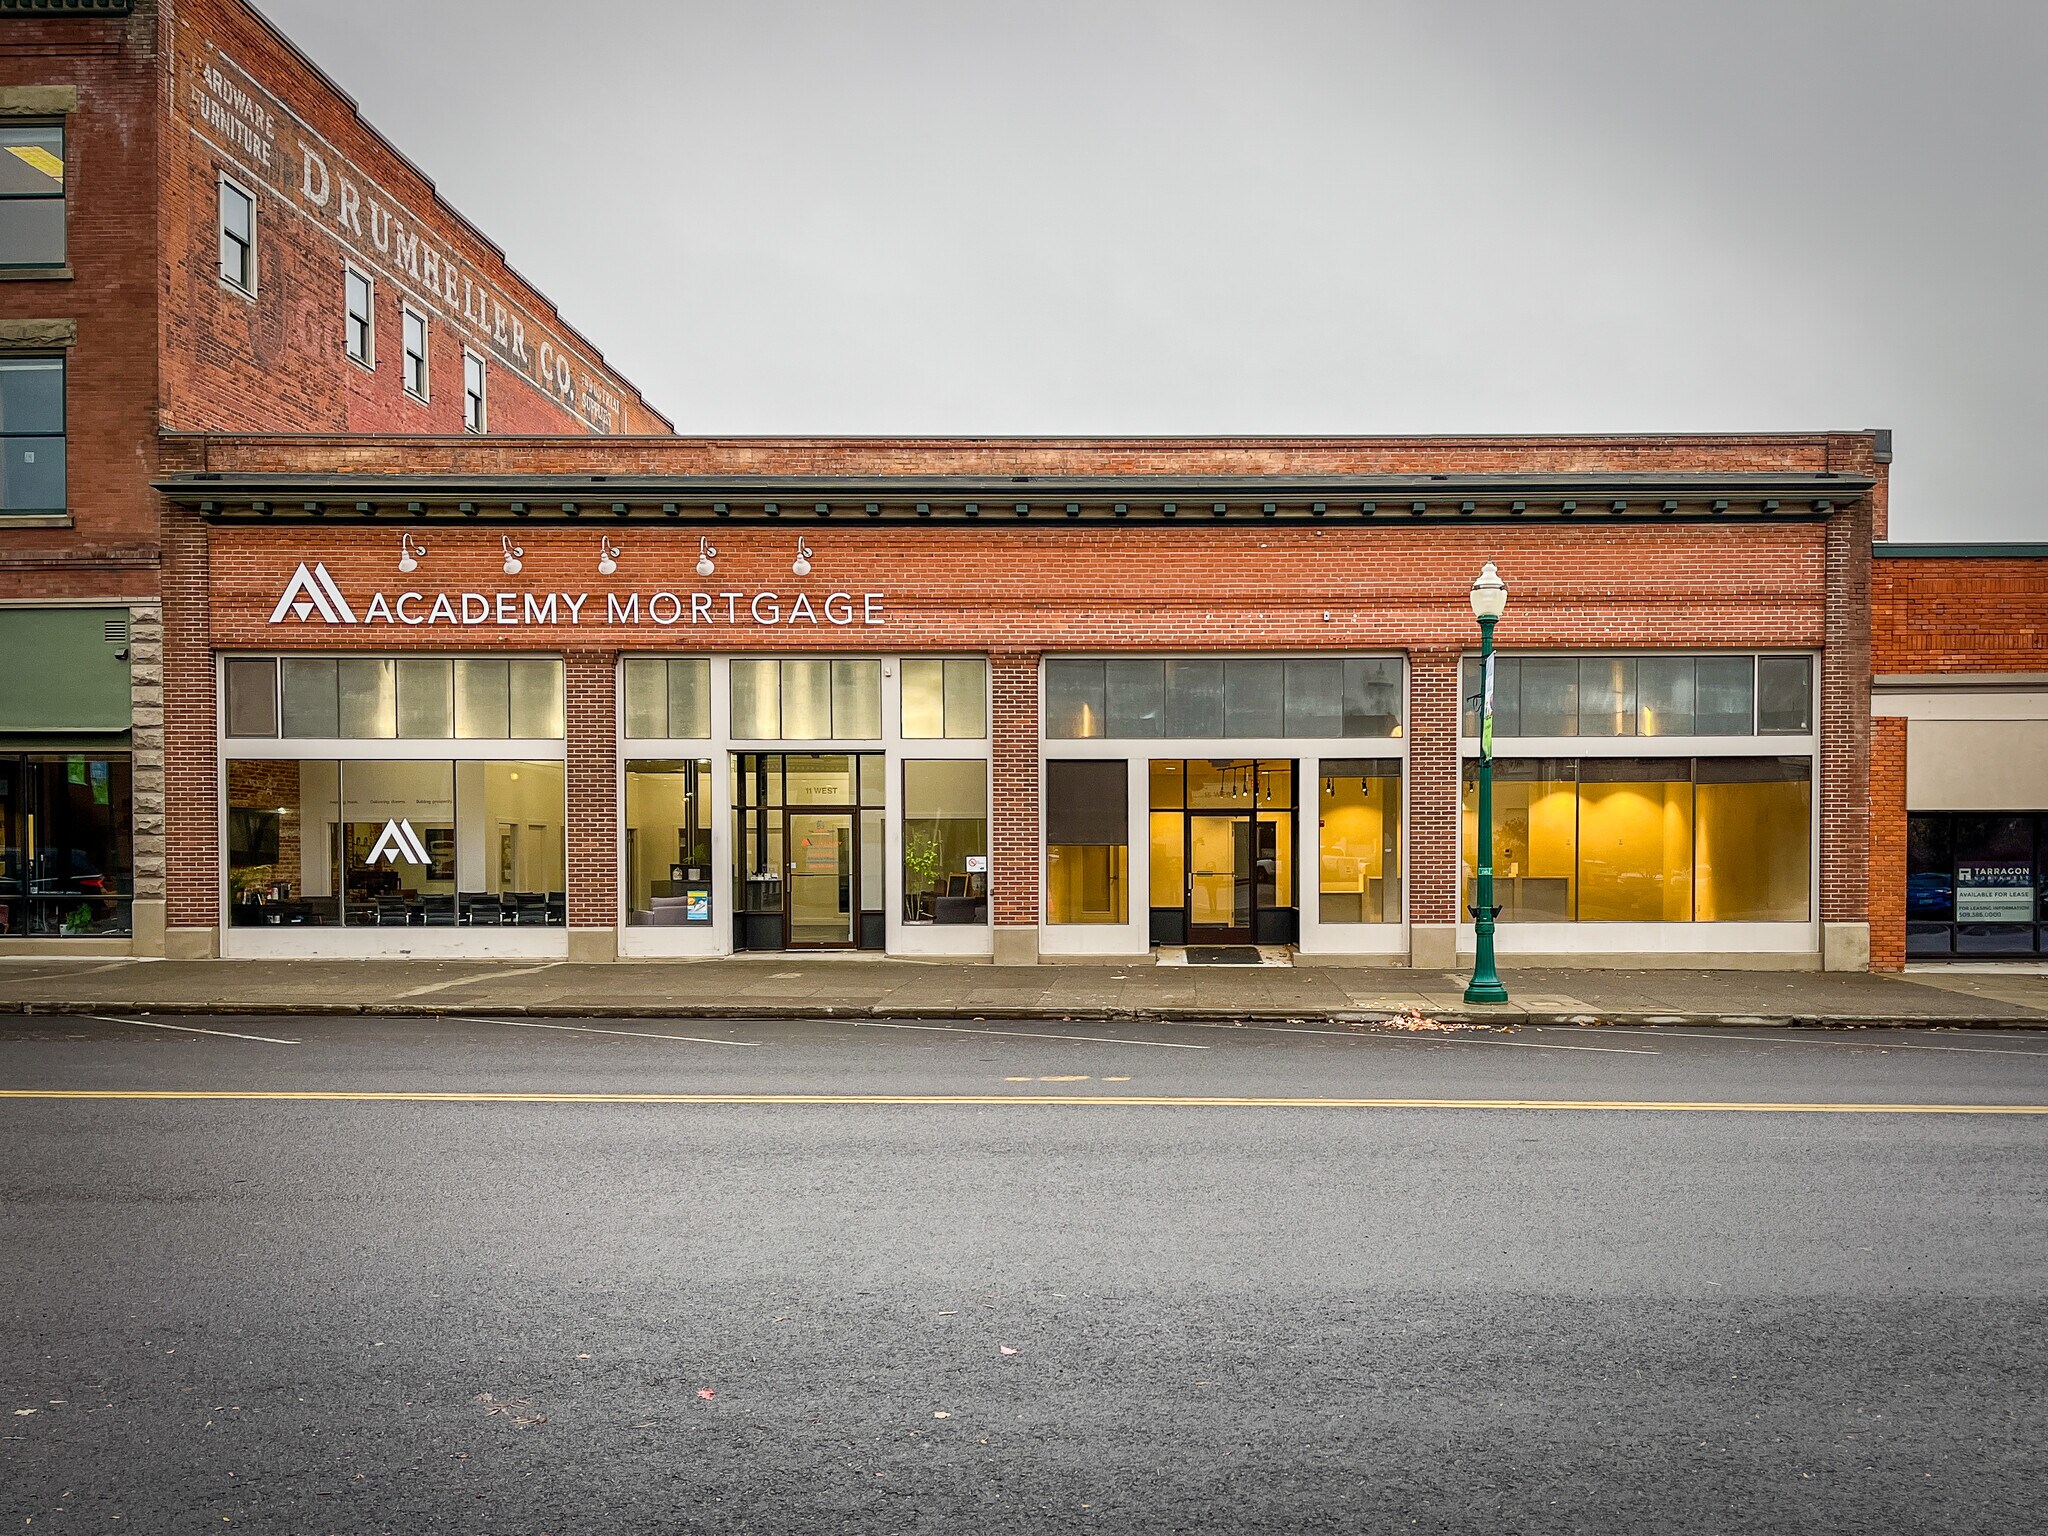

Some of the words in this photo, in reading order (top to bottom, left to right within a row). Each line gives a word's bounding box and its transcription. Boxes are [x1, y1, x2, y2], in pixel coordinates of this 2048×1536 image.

[194, 56, 275, 140] ARDWARE
[298, 139, 529, 365] DRUMHELLER
[364, 592, 588, 624] ACADEMY
[607, 592, 886, 624] MORTGAGE
[813, 786, 838, 795] WEST
[1974, 867, 2030, 875] TARRAGON
